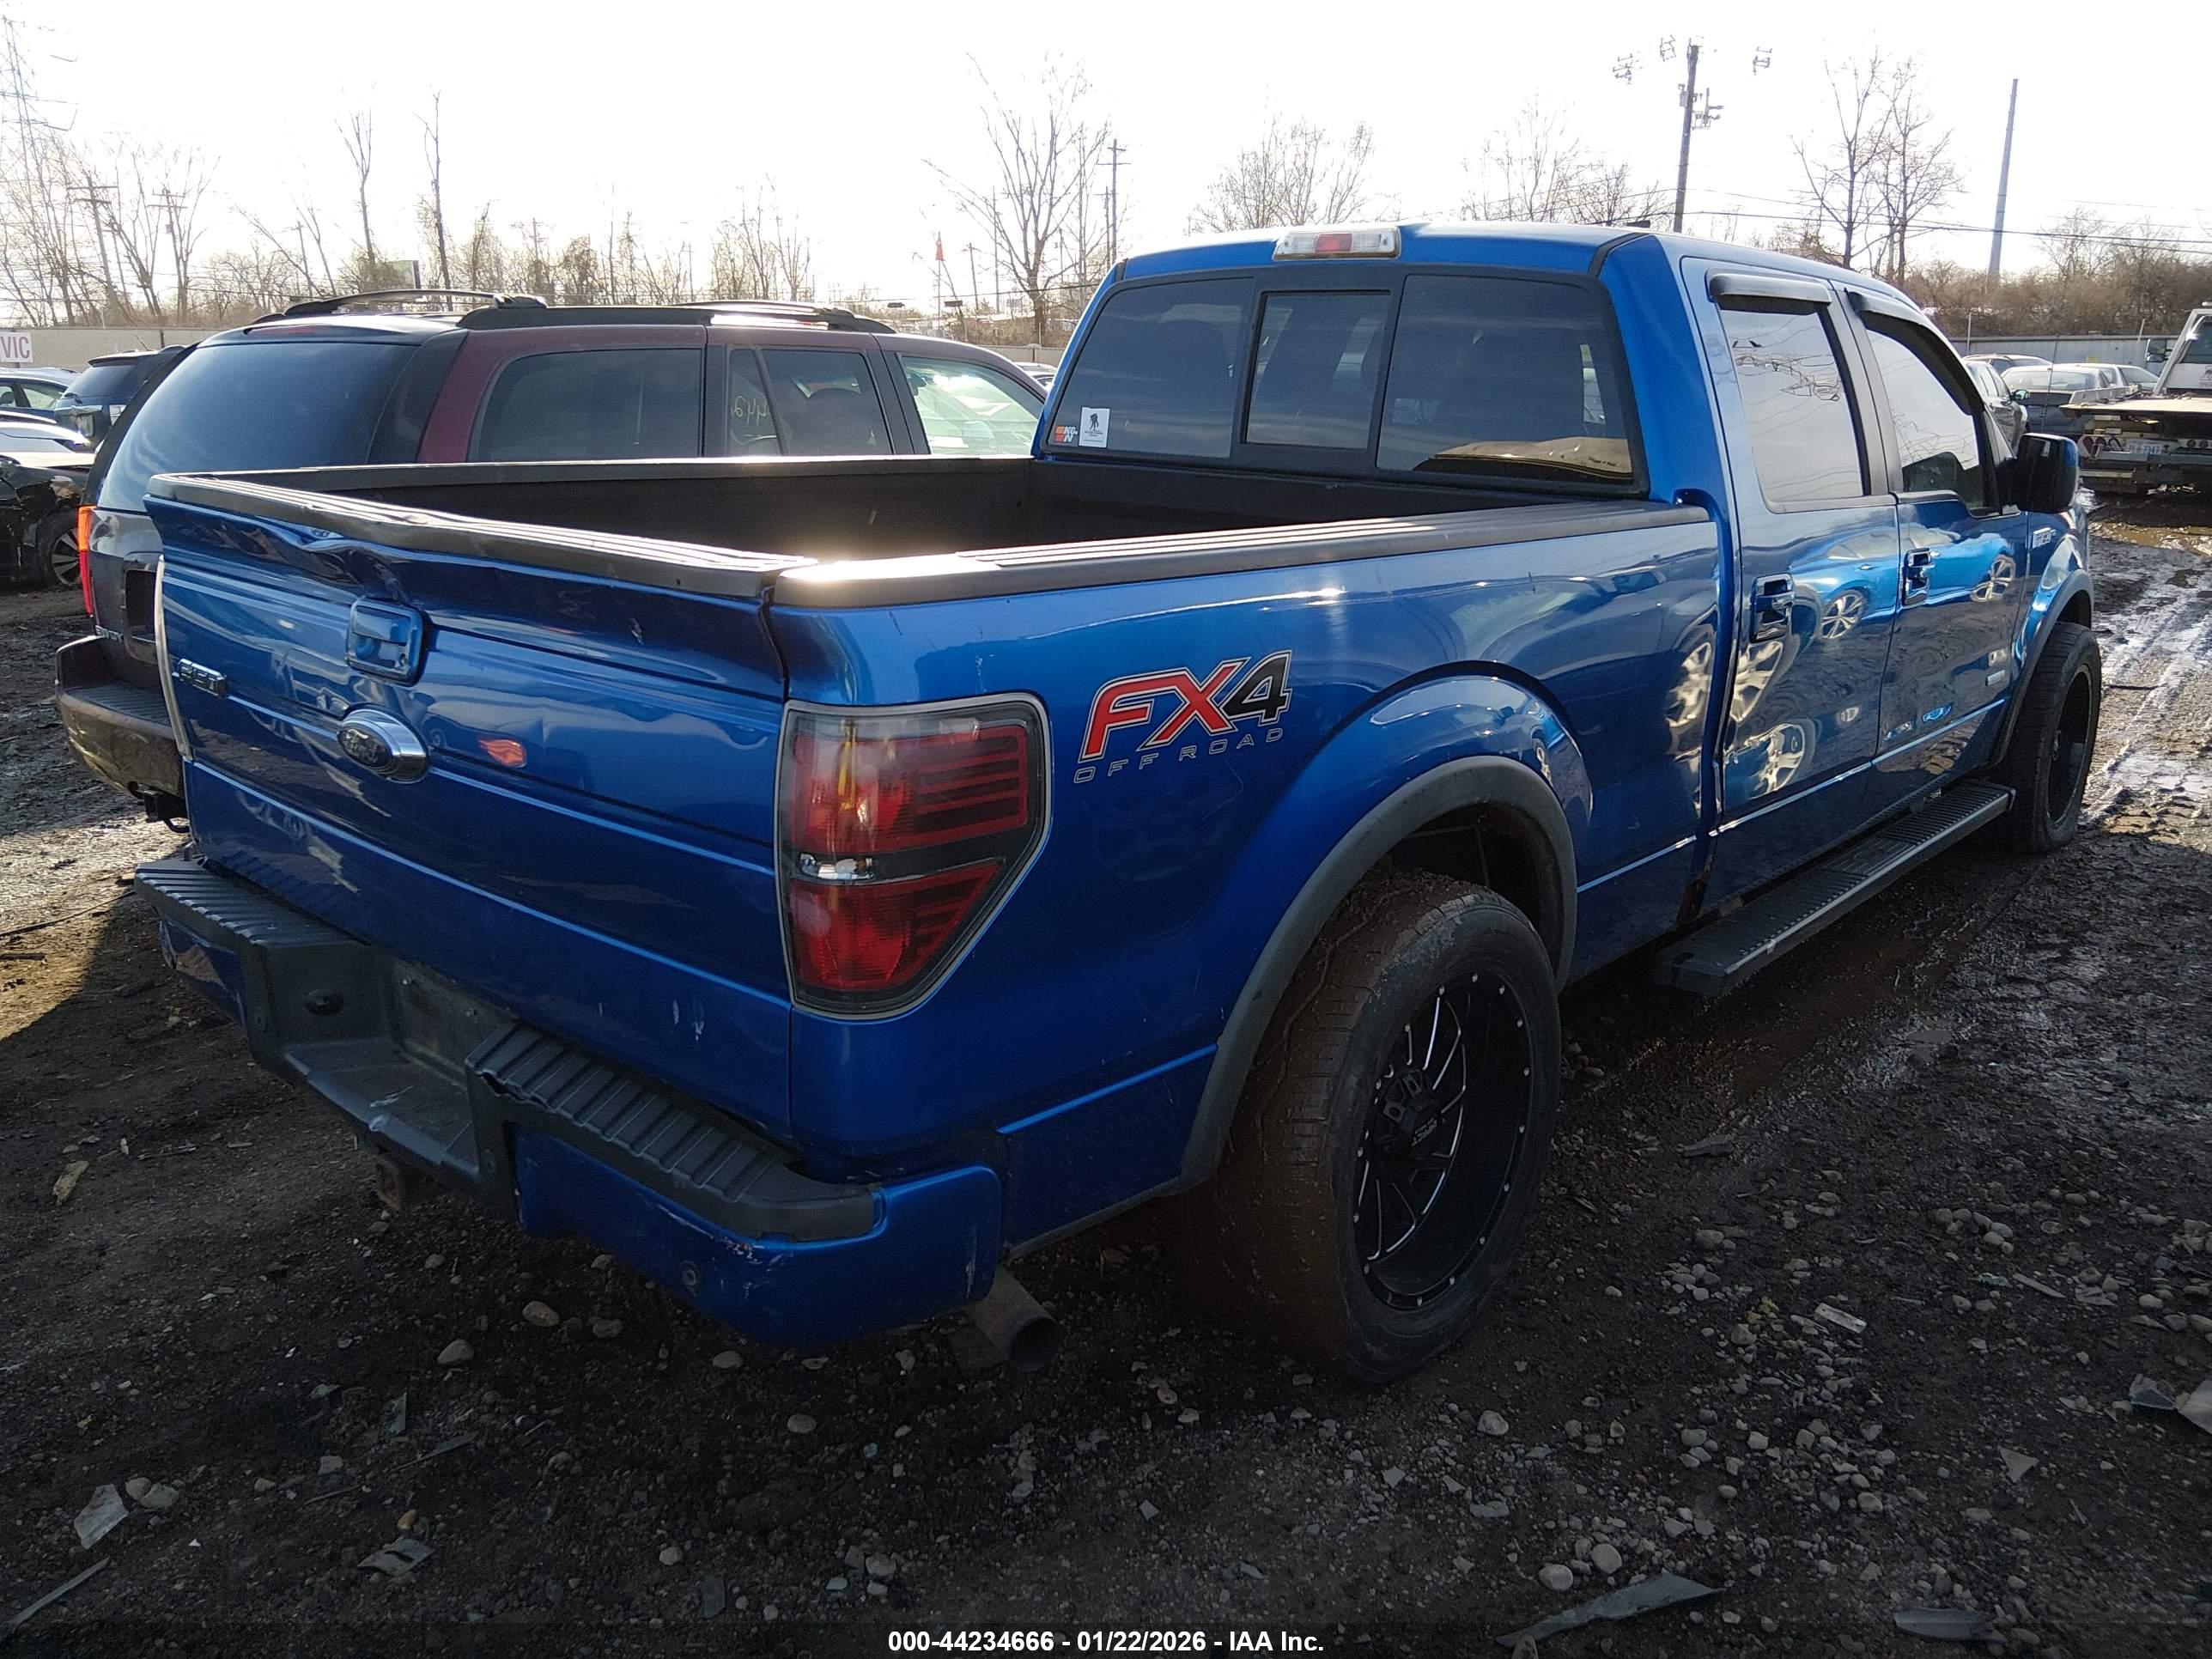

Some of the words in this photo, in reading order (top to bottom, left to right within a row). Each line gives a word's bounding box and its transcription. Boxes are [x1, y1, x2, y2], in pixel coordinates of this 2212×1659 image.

[1078, 649, 1292, 763] FX4
[1073, 752, 1159, 784] OFF
[1178, 727, 1284, 762] ROAD
